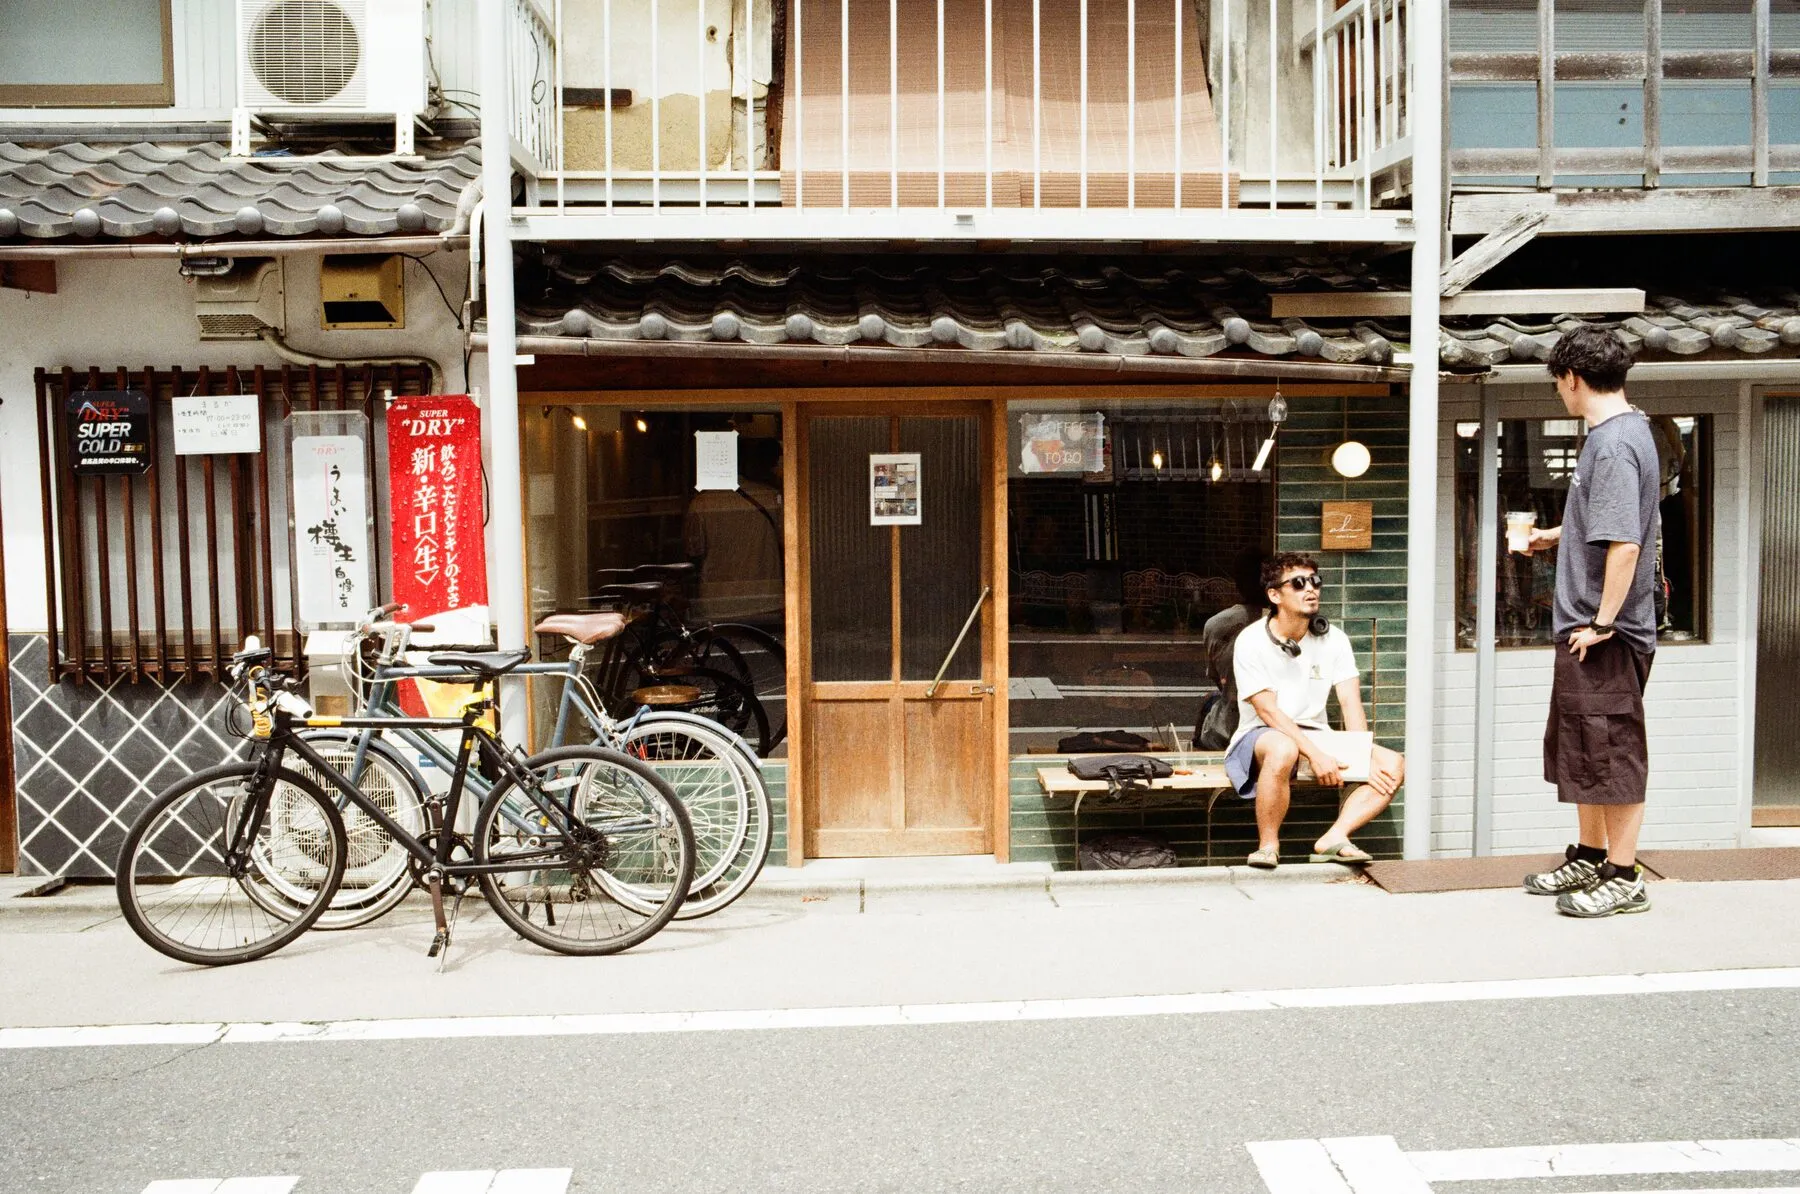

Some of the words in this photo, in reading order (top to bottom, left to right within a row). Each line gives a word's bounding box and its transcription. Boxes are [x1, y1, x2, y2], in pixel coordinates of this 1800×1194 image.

[419, 409, 449, 418] SUPER
[77, 422, 132, 438] SUPER
[1039, 421, 1087, 434] COFFEE
[78, 439, 121, 454] COLD
[1044, 452, 1061, 464] TO
[1064, 452, 1082, 464] GO
